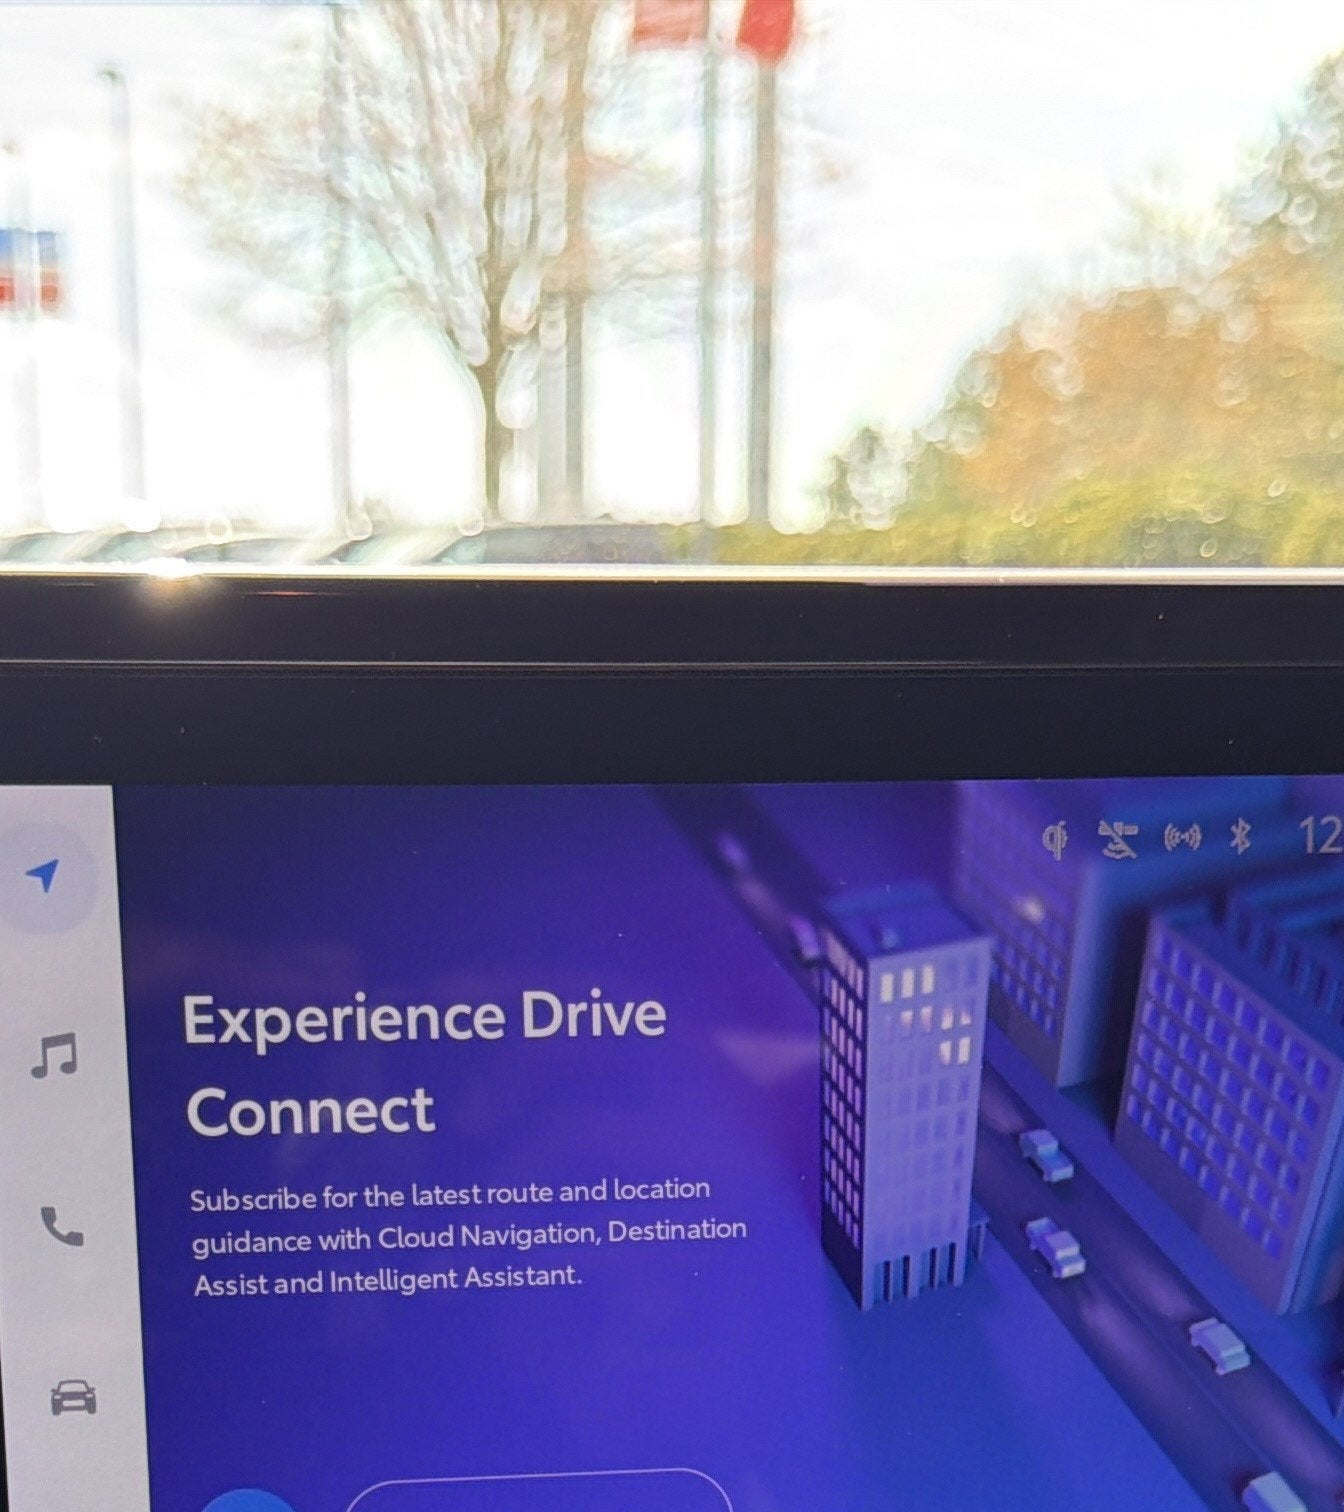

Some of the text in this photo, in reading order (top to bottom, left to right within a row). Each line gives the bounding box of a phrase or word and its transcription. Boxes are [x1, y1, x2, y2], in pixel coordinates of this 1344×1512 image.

[184, 987, 667, 1056] Experience Drive
[187, 1087, 436, 1137] Connect
[190, 1177, 710, 1212] Subscribe for the latest route and location
[192, 1217, 747, 1260] guidance with Cloud Navigation, Destination
[194, 1265, 583, 1297] Assist and Intelligent Assistant.
